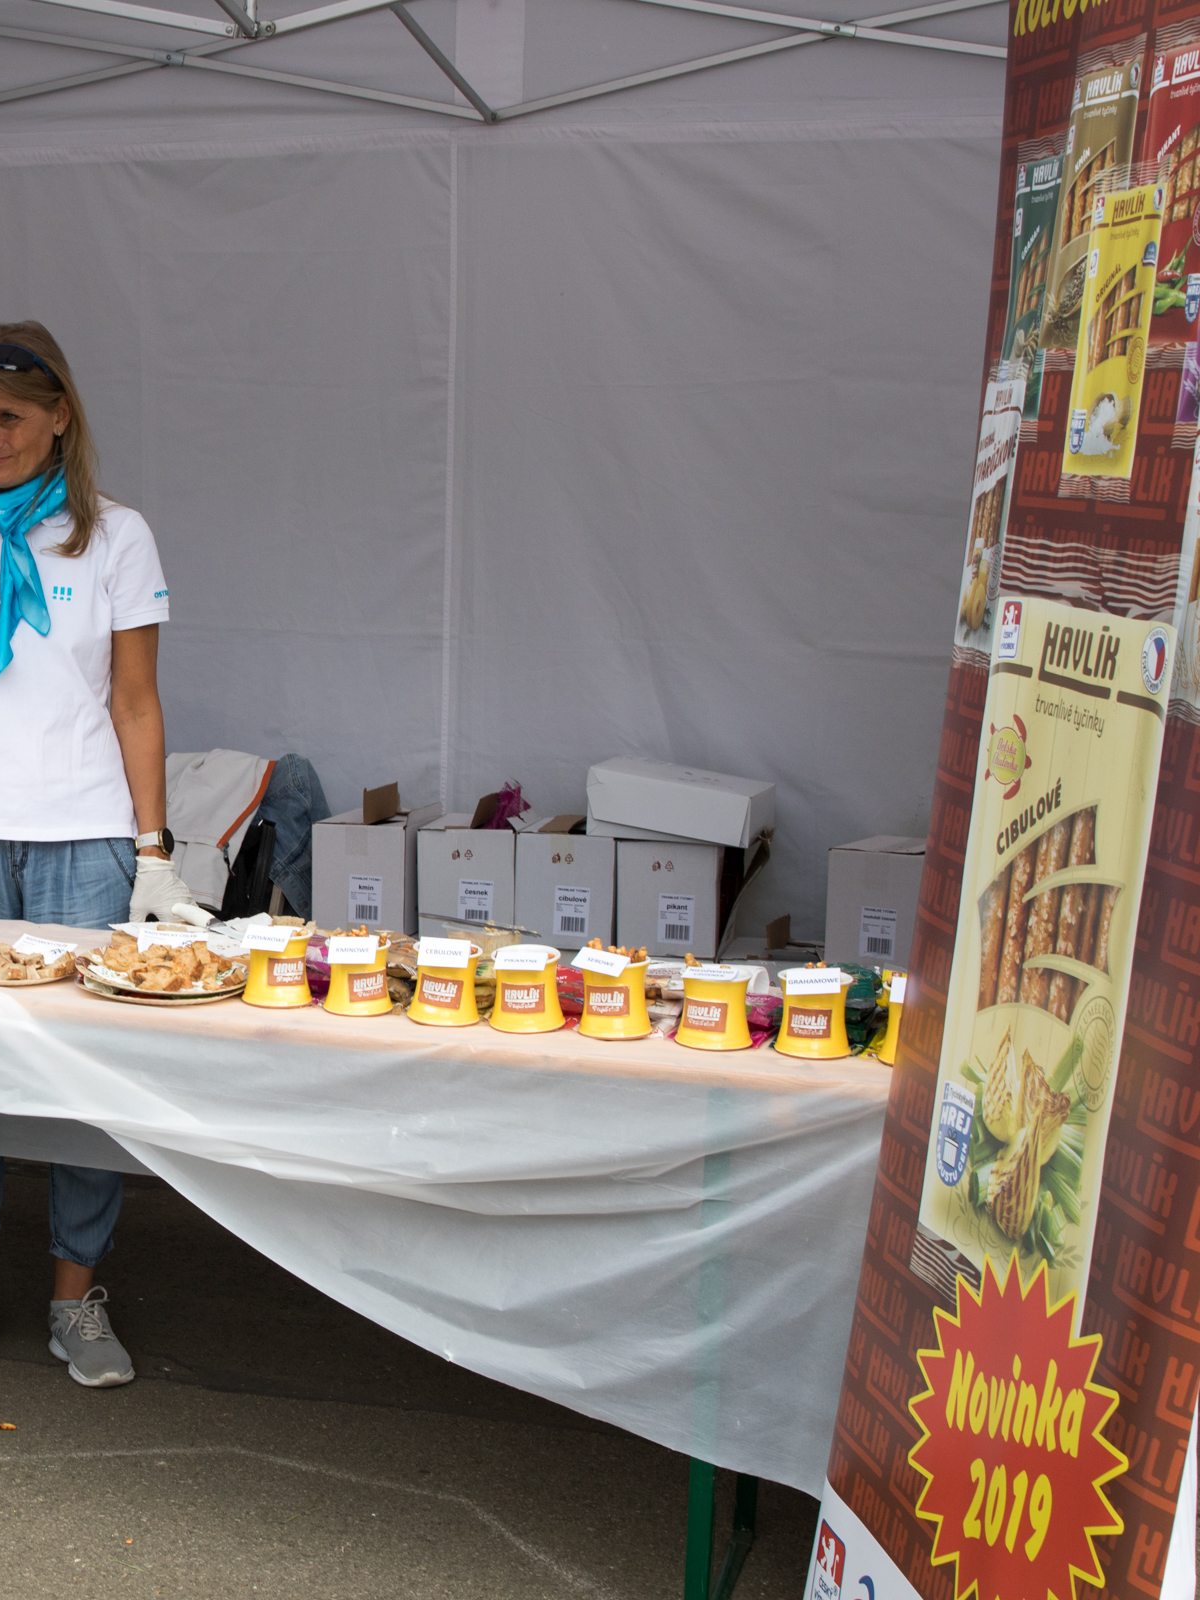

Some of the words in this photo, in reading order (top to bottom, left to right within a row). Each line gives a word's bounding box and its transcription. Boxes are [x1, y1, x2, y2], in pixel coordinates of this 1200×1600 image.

[1085, 71, 1124, 105] HAVLÍK
[1157, 124, 1181, 163] PIKANT
[1112, 191, 1146, 227] HAVLÍK
[1038, 621, 1121, 699] HAVLÍK
[1035, 694, 1073, 724] trvanlivé
[1073, 706, 1105, 738] tyčinky
[996, 777, 1063, 855] CIBULOVÉ
[464, 888, 488, 896] česnek
[558, 895, 587, 903] cibulové
[666, 903, 688, 911] pikant
[425, 948, 463, 957] CEBULOWE
[788, 977, 839, 985] GRAHAMOWE
[940, 1104, 971, 1135] HREJ
[945, 1348, 1086, 1458] Novinka
[962, 1458, 1053, 1562] 2019
